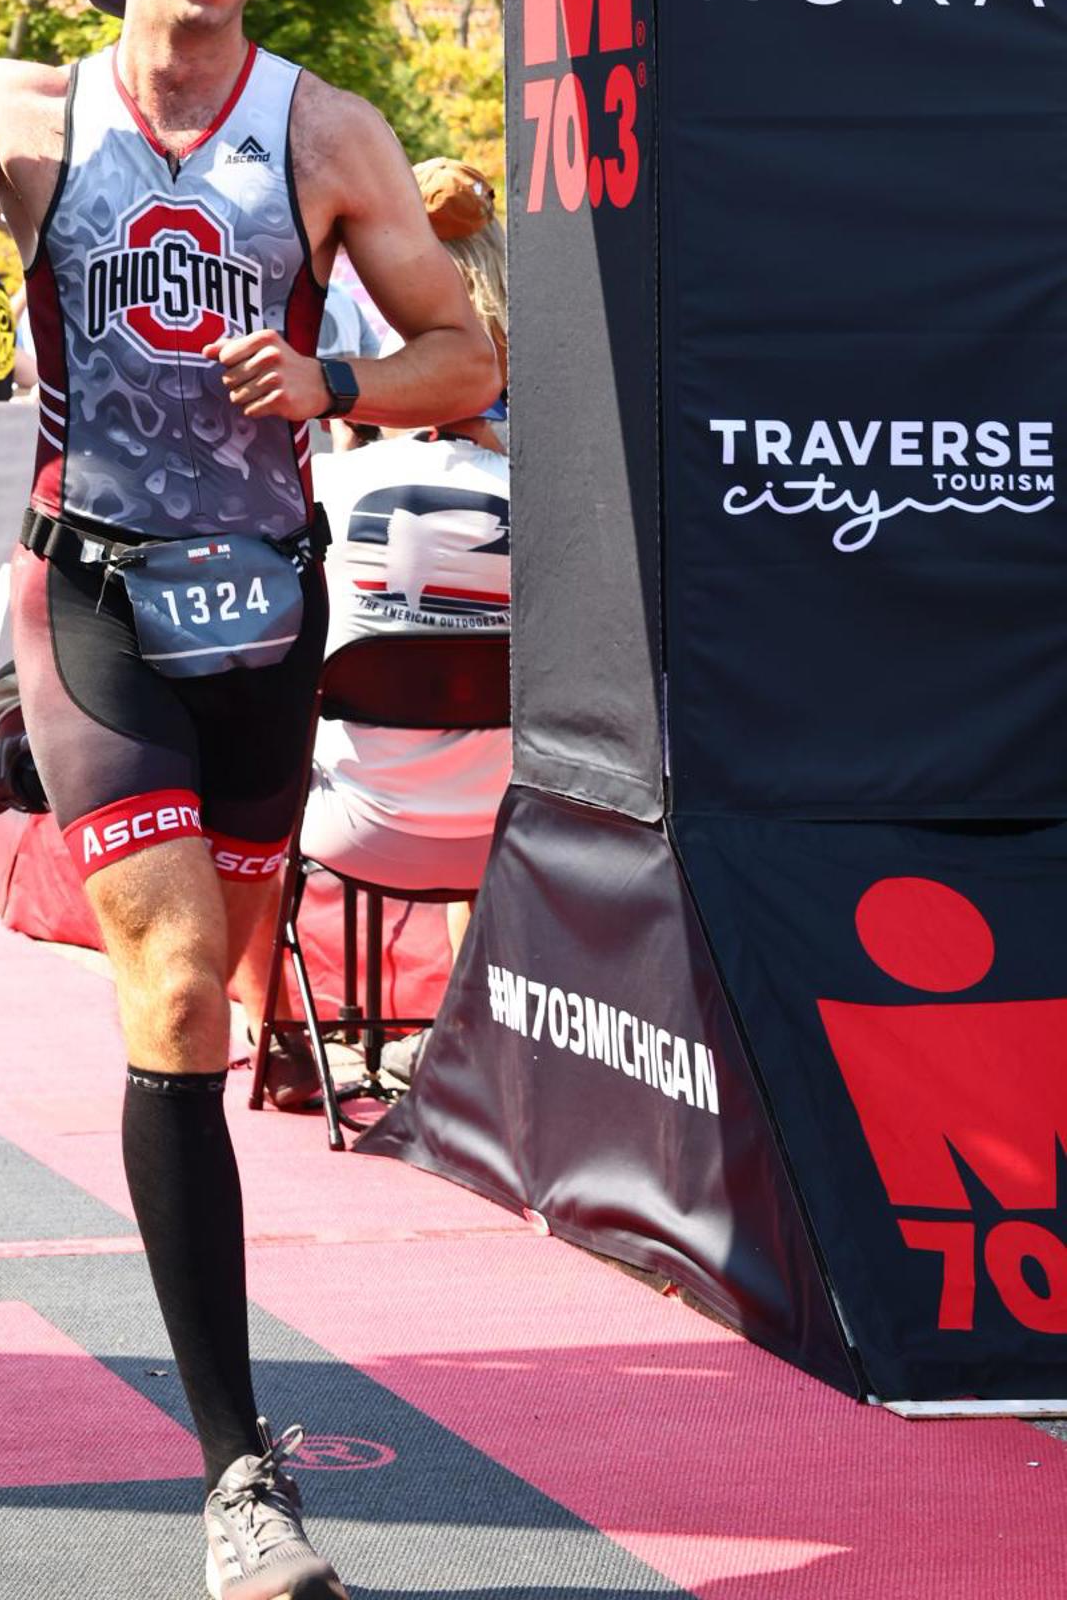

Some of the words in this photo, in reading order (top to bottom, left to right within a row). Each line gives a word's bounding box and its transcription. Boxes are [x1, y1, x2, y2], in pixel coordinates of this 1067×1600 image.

[524, 64, 640, 212] 70.3
[88, 250, 160, 338] OHIO
[163, 242, 260, 336] STATE
[710, 419, 1054, 467] TRAVERSE
[933, 473, 1055, 492] TOURISM
[723, 473, 882, 552] city
[162, 577, 270, 626] 1324
[383, 605, 436, 625] AMERICAN
